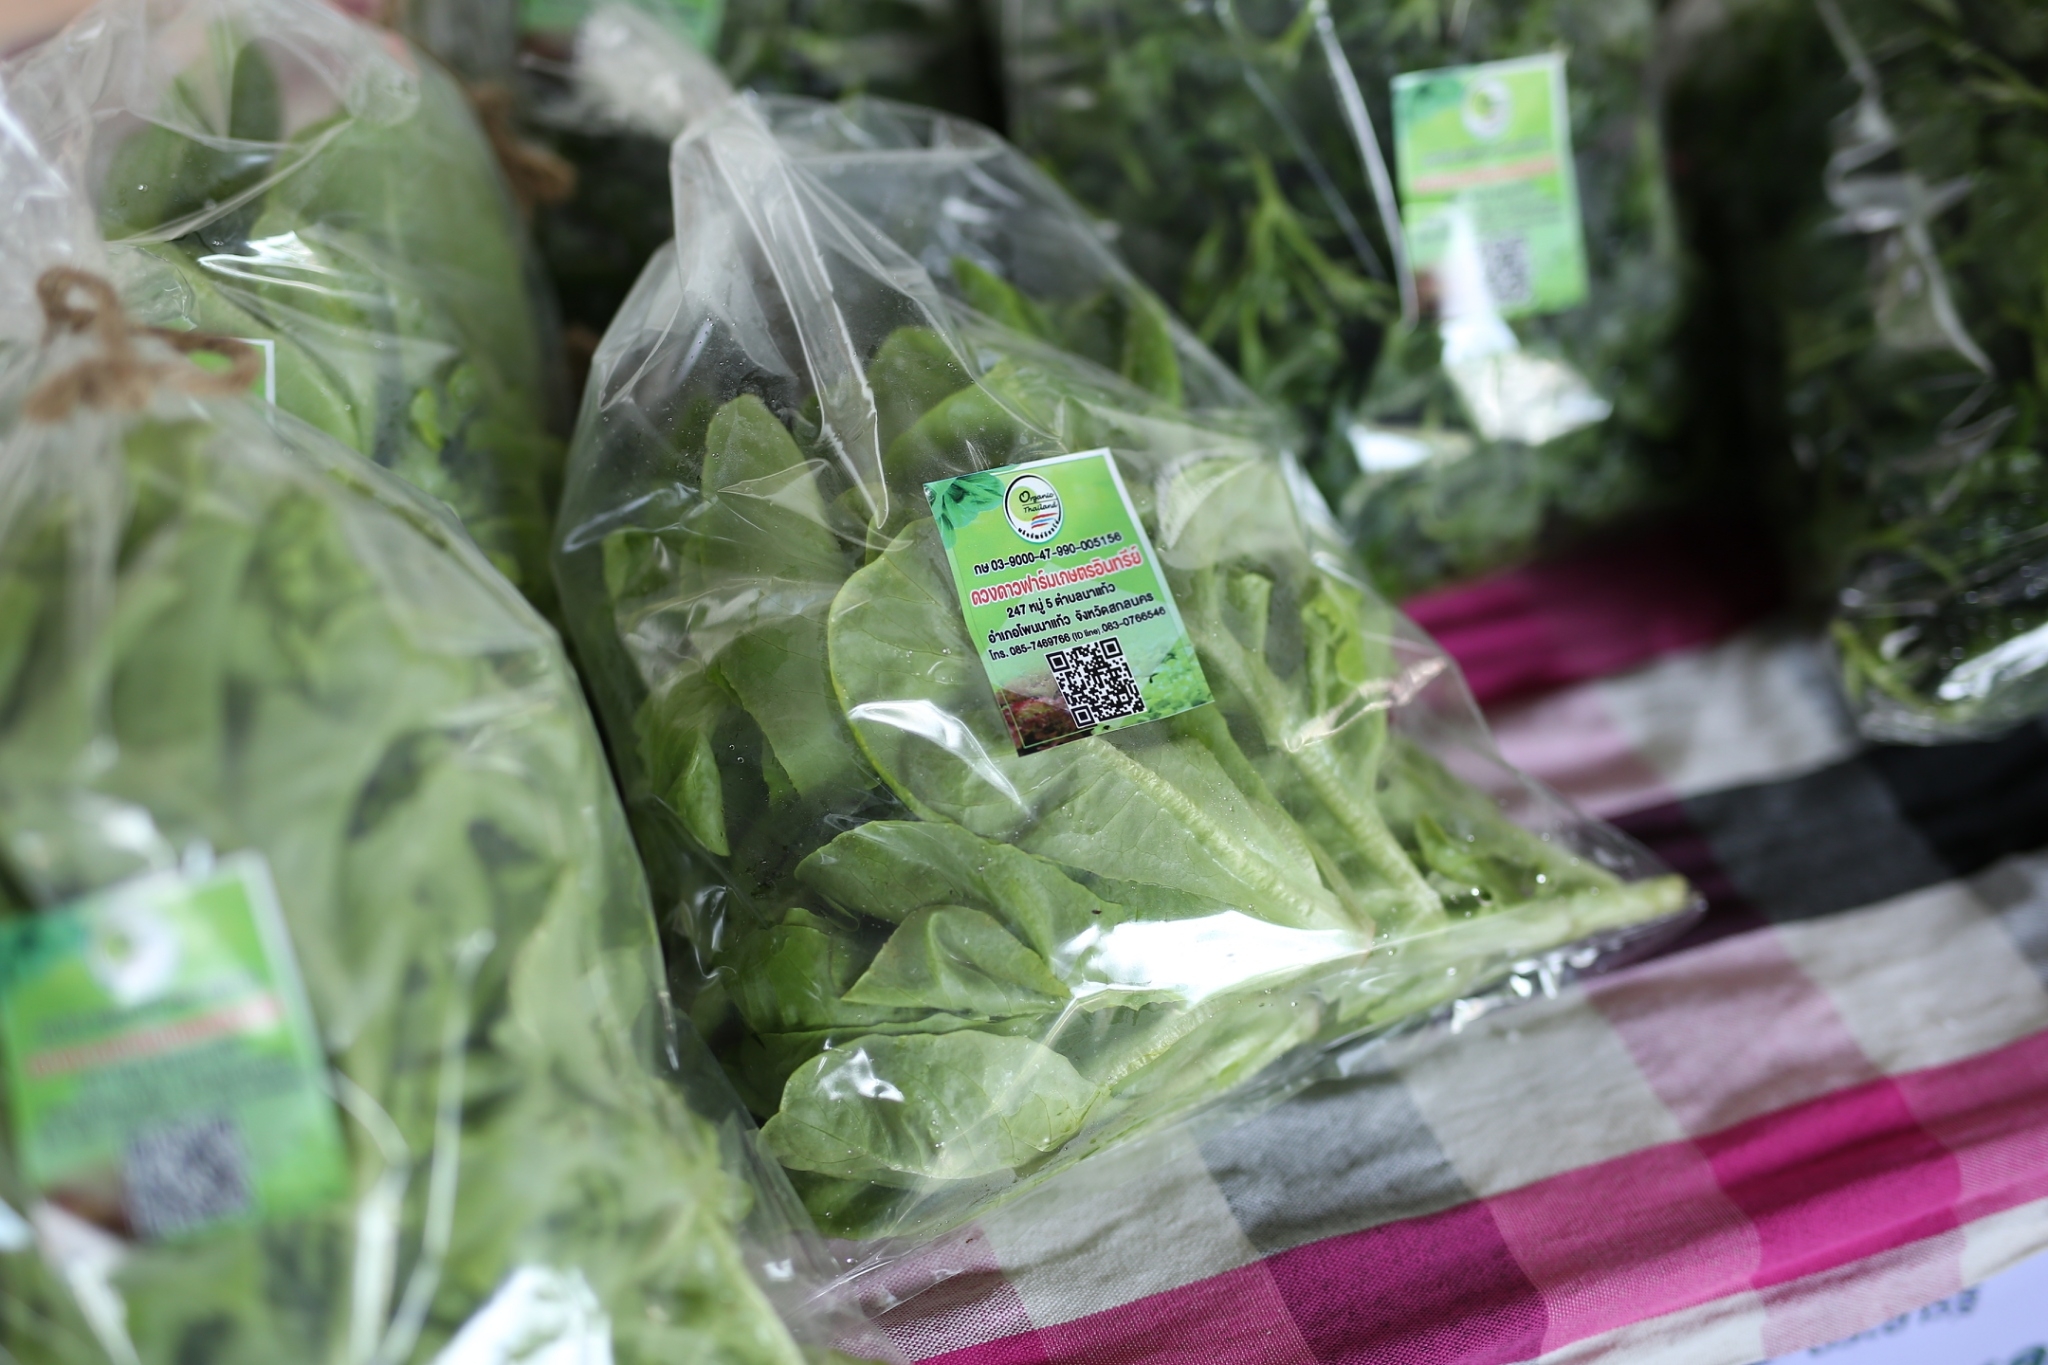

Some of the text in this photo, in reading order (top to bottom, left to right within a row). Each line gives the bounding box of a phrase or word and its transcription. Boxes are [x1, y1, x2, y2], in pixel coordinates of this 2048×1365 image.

[1019, 490, 1054, 504] Organic
[1023, 501, 1058, 513] Thailand
[974, 532, 1122, 575] กษ 03-9000-47-990-005156
[971, 545, 1142, 605] ดวงดาวฟาร์มเกษตรอินทรีย์
[988, 592, 1154, 643] อำเภอโพนนาแก้ว จังหวัดสกลนคร
[1007, 582, 1116, 618] 247 หมู่ 5 ตำบลนาแก้ว
[988, 649, 1009, 661] โทร.
[1009, 633, 1071, 656] 085-7469766
[1072, 631, 1084, 642] (ID
